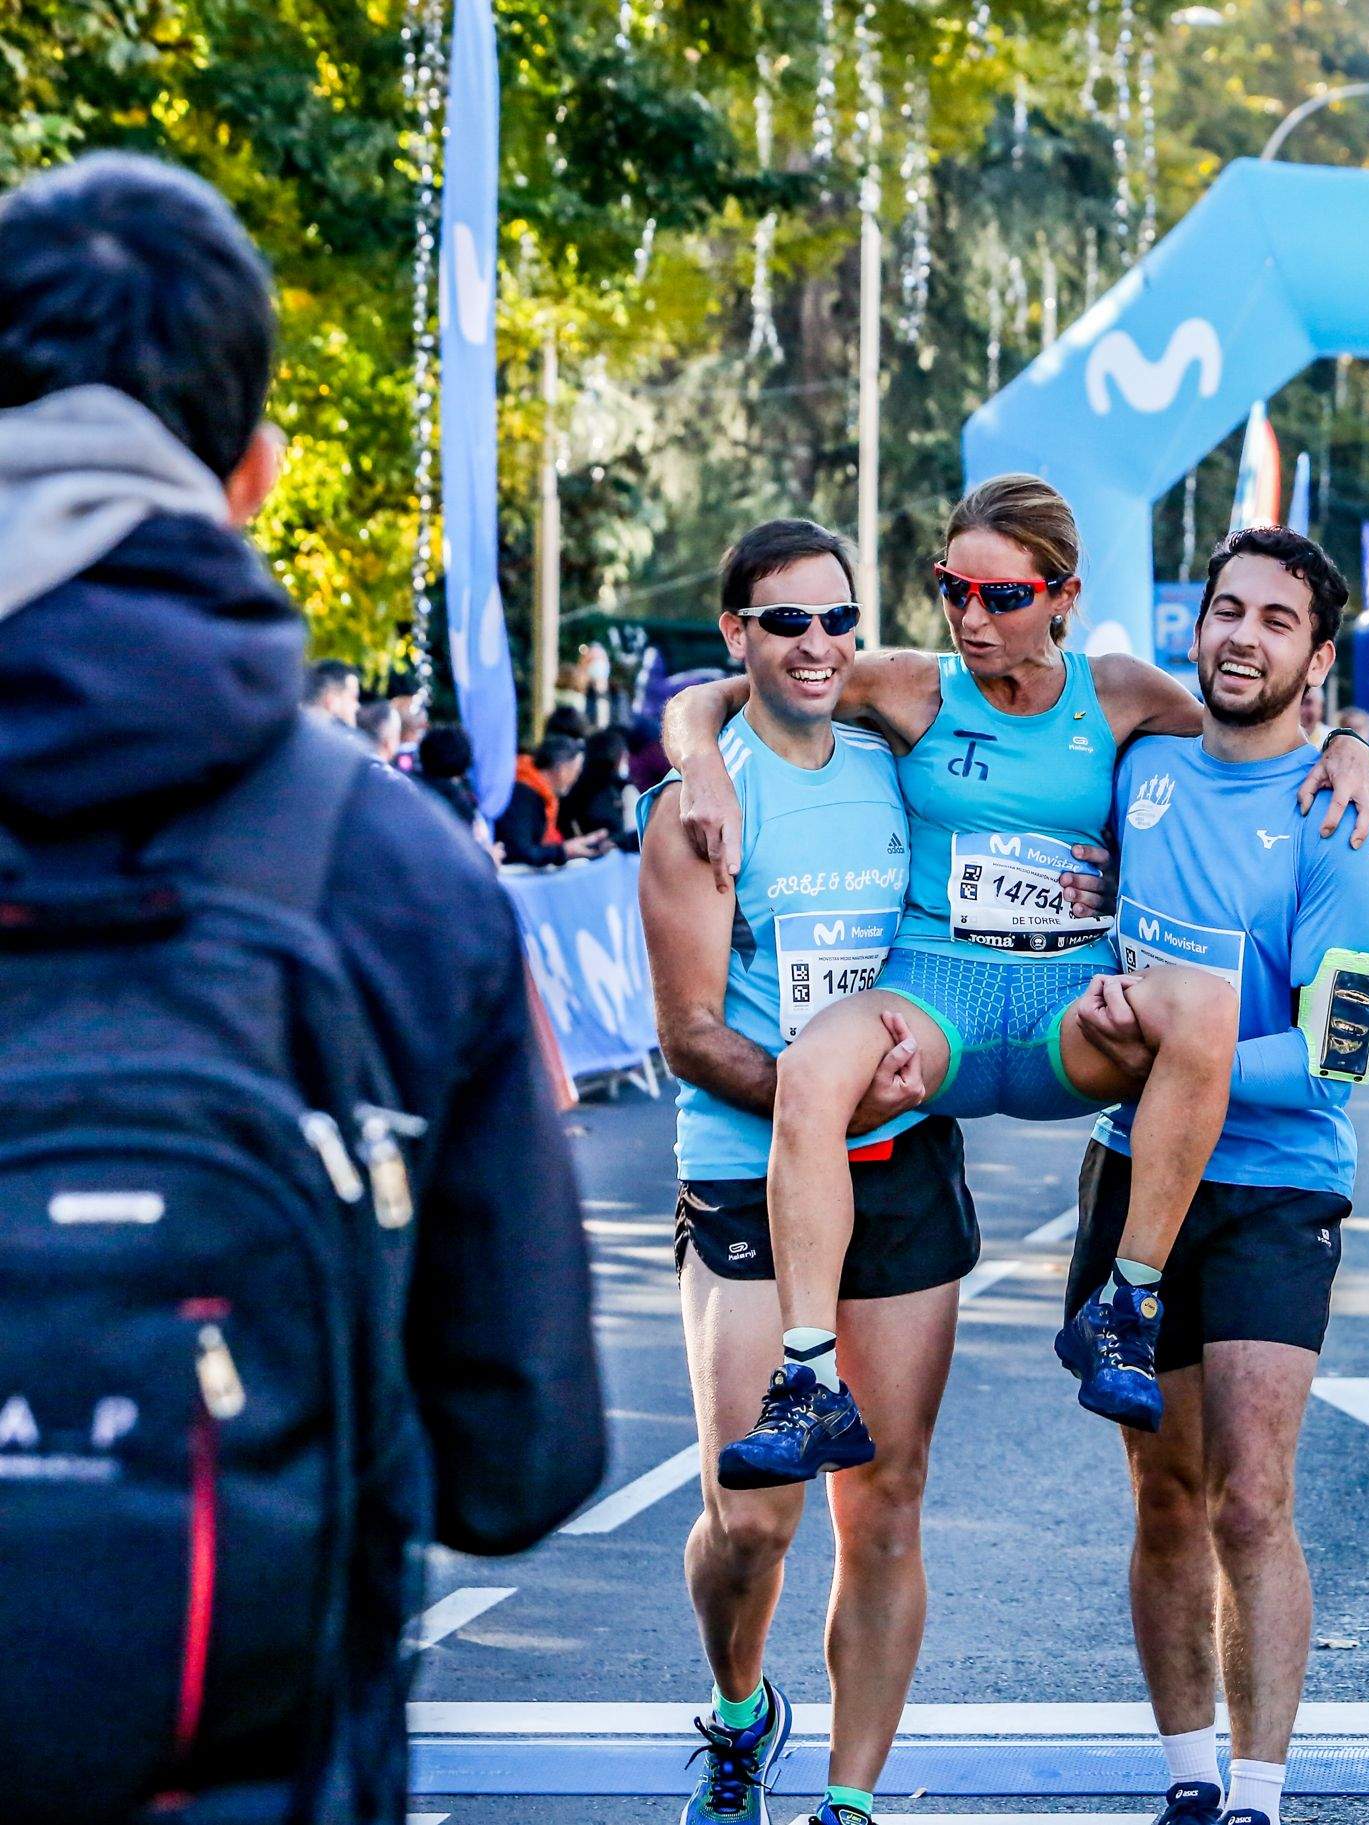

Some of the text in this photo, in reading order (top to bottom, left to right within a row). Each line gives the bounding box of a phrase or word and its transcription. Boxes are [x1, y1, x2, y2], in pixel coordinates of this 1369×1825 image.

[1027, 848, 1080, 871] Movistar
[993, 875, 1064, 915] 14754
[851, 925, 884, 938] Movistar
[1012, 916, 1062, 926] DE TORRE
[1163, 931, 1208, 954] Movistar
[823, 967, 876, 995] 14756
